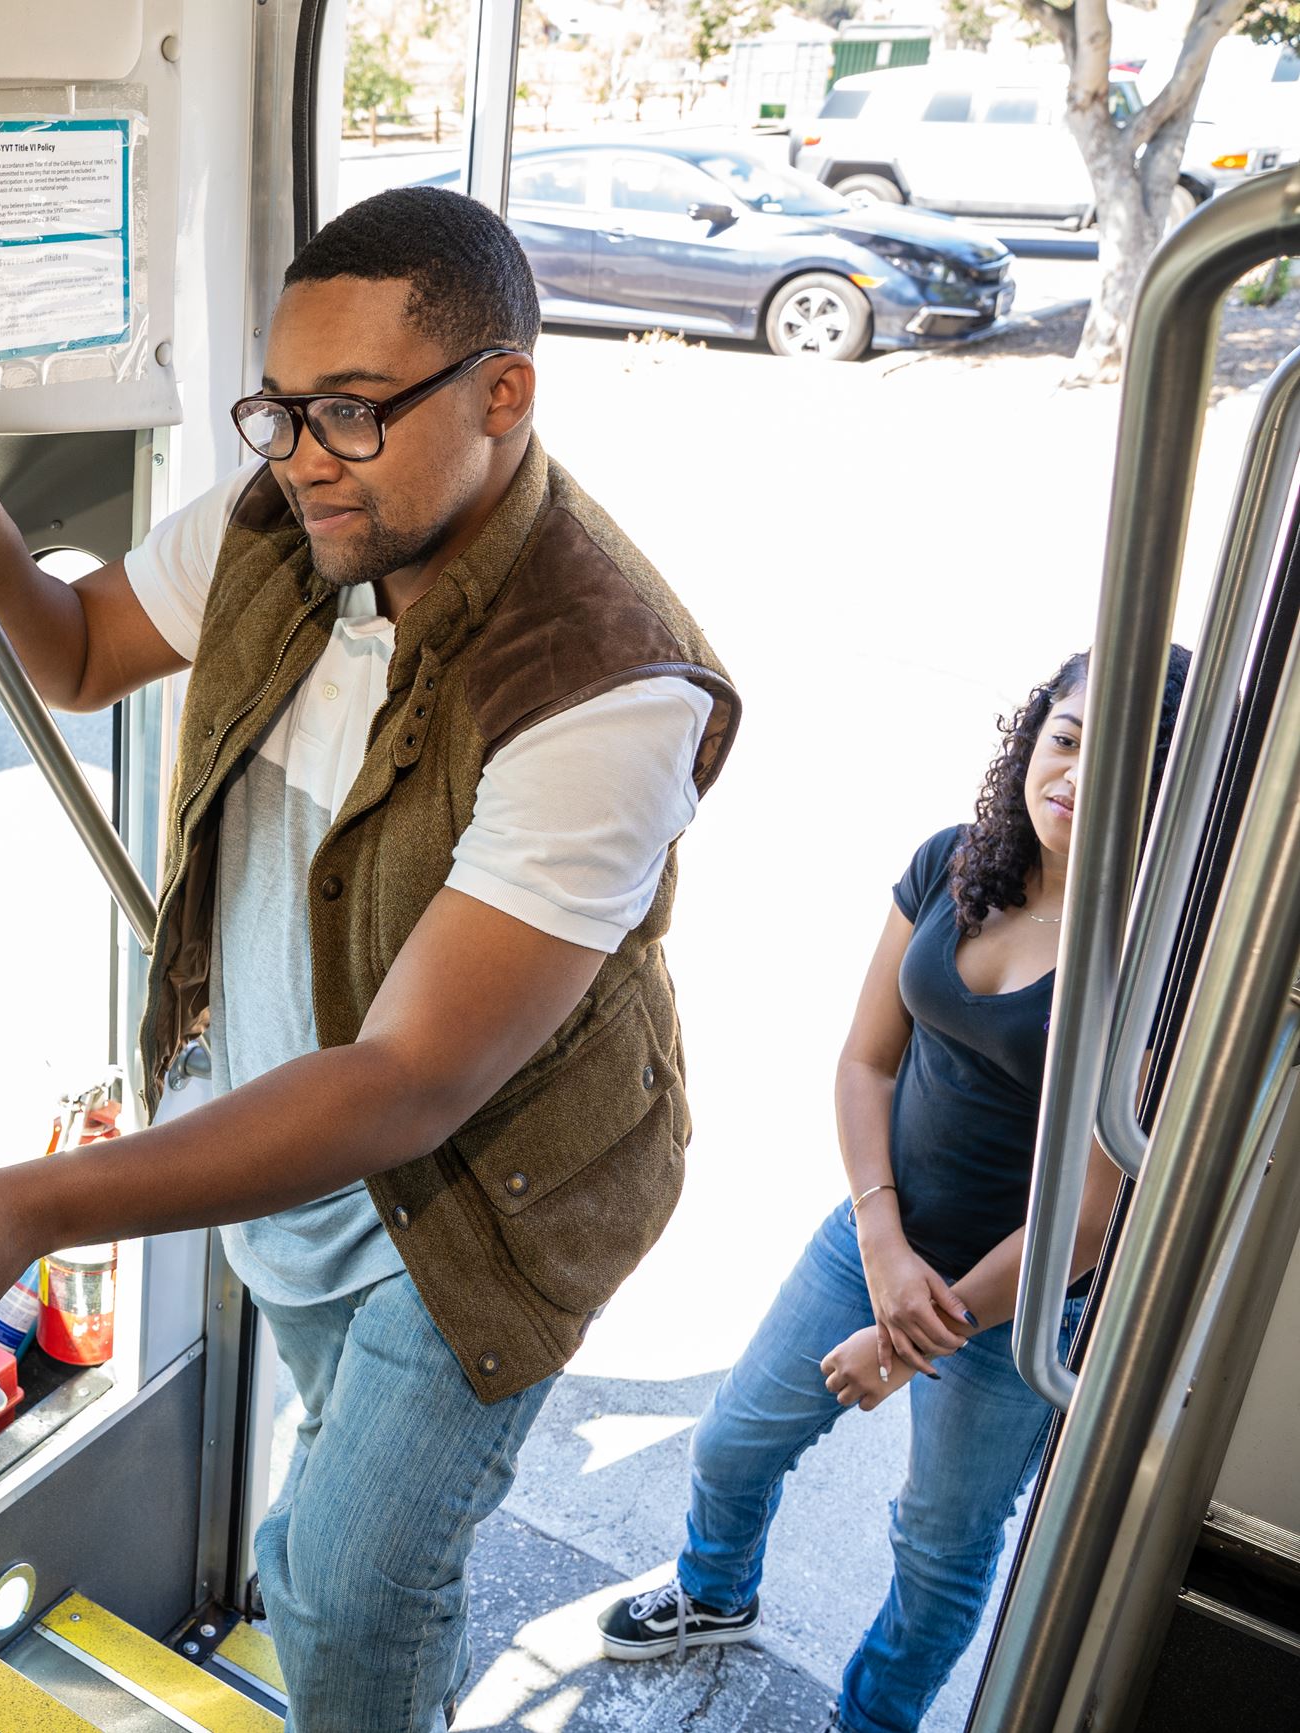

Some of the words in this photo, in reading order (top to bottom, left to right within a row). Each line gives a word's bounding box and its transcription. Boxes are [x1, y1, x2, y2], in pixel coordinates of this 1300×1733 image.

[15, 143, 28, 152] Title
[30, 143, 36, 151] VI
[38, 143, 55, 152] Policy
